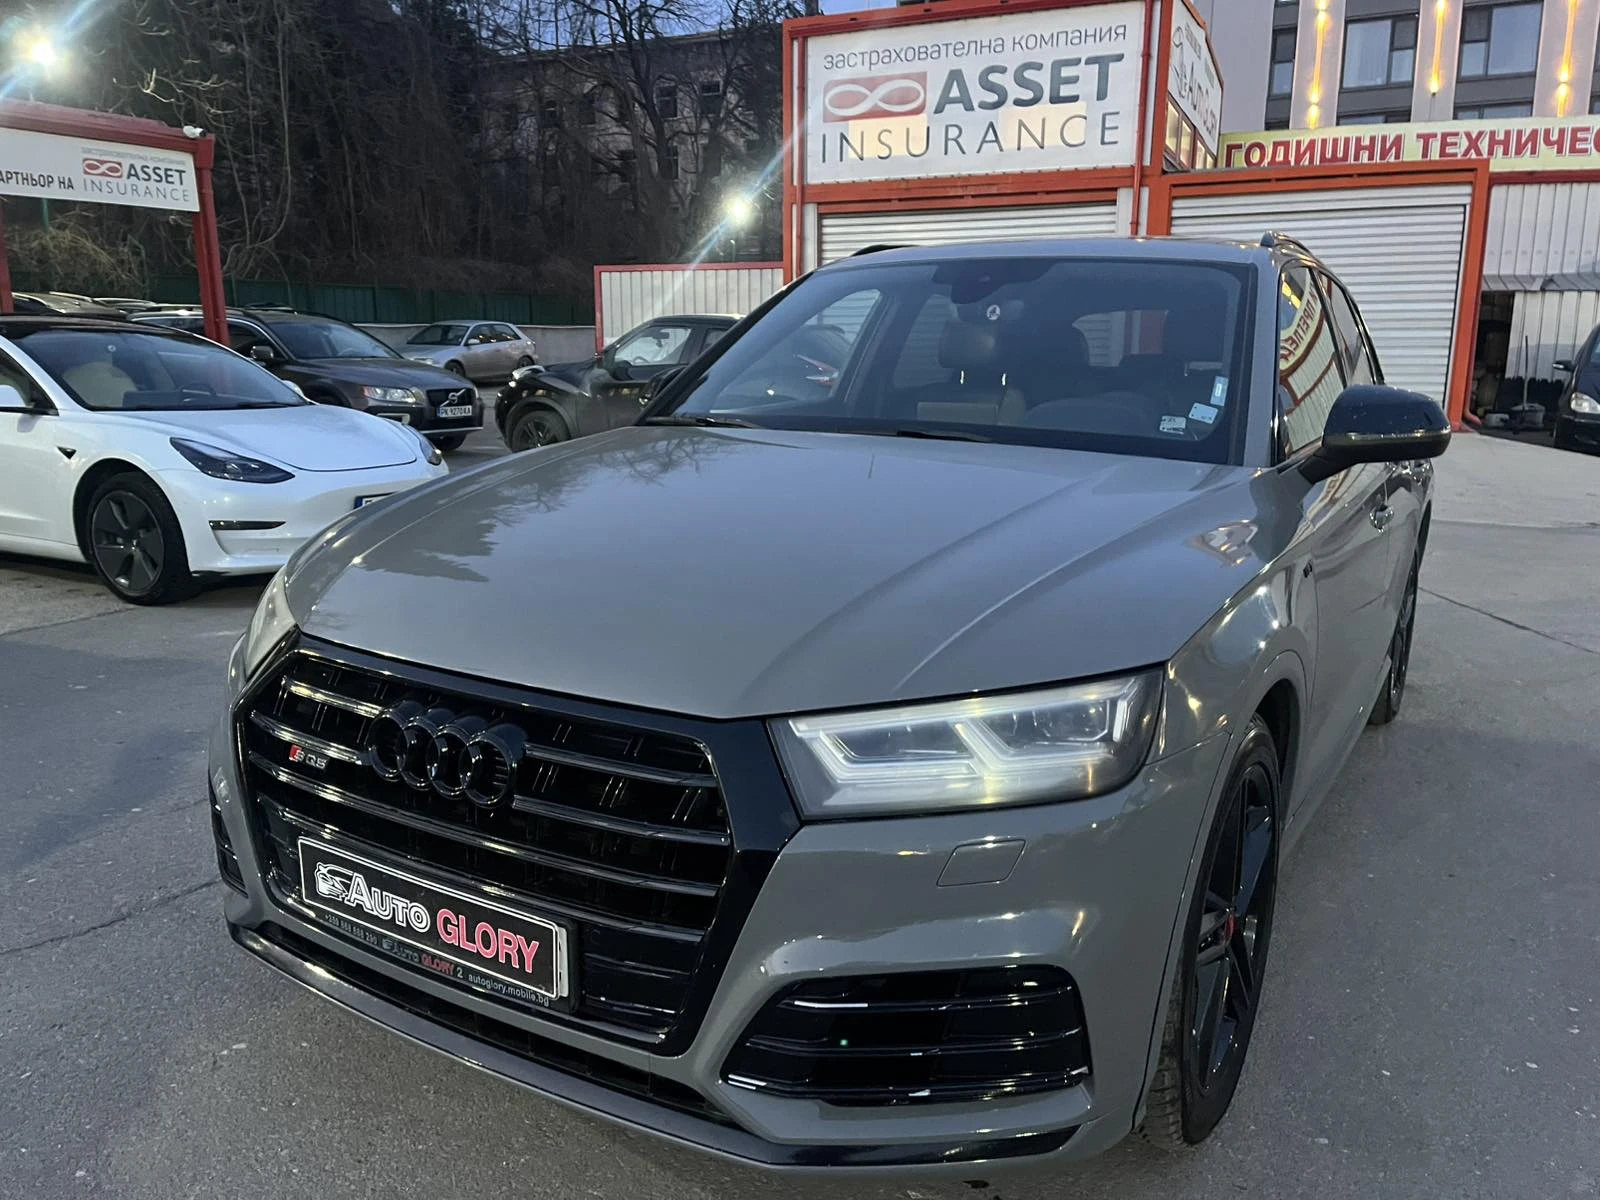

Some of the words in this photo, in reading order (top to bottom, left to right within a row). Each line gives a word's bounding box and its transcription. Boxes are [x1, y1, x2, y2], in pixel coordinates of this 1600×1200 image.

[823, 34, 1005, 71] застрахователна
[1011, 23, 1127, 51] компания
[933, 53, 1125, 115] ASSET
[821, 110, 1120, 164] INSURANCE
[1224, 133, 1406, 168] ГОДИШНИ
[57, 176, 75, 190] НА
[83, 178, 191, 202] INSURANCE
[126, 163, 187, 186] ASSET
[345, 872, 431, 933] AUTO
[436, 908, 540, 973] GLORY
